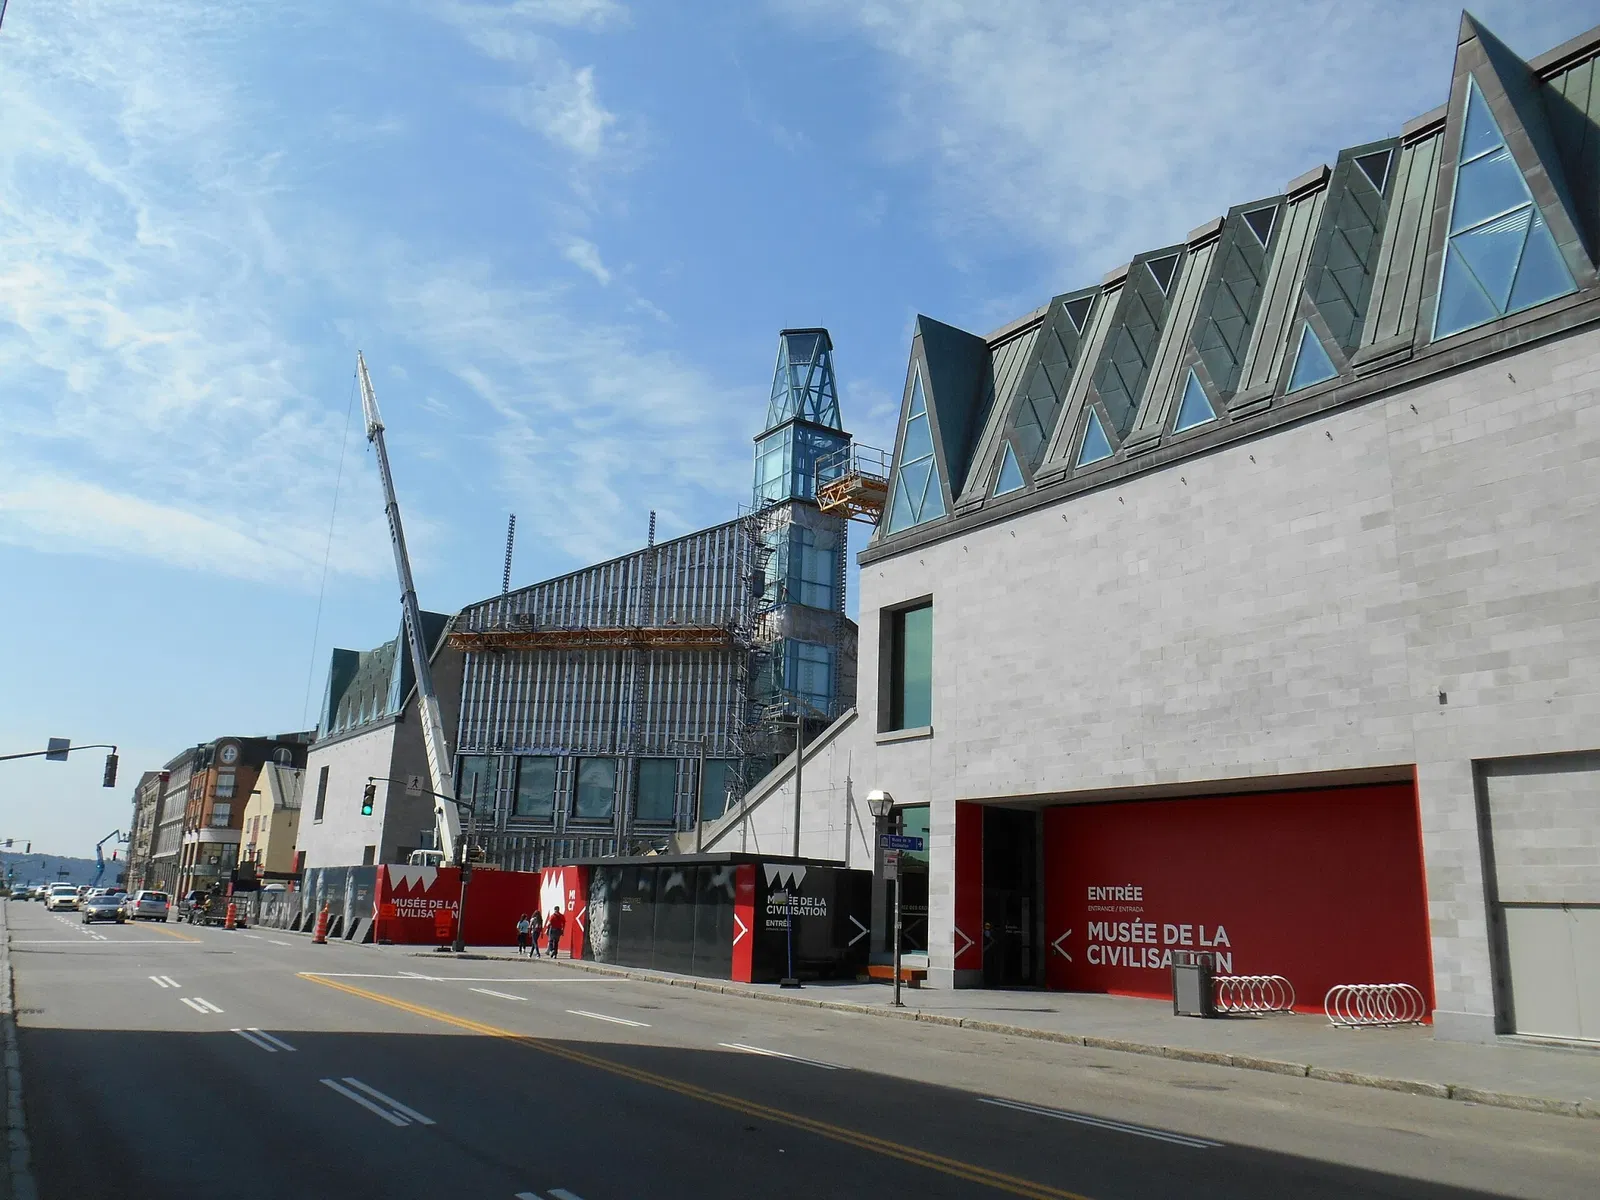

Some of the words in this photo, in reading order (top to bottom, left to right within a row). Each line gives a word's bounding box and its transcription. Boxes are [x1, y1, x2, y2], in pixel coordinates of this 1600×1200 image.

[1088, 883, 1143, 901] ENTRÉE
[391, 896, 427, 908] MUSÉE
[428, 900, 443, 909] DE
[444, 900, 459, 909] LA
[767, 893, 799, 906] MÉE
[800, 897, 813, 906] DE
[814, 897, 827, 907] LA
[766, 905, 827, 917] CIVILISATION
[1088, 917, 1157, 944] MUSÉE
[1163, 923, 1194, 946] DE
[1199, 924, 1231, 948] LA
